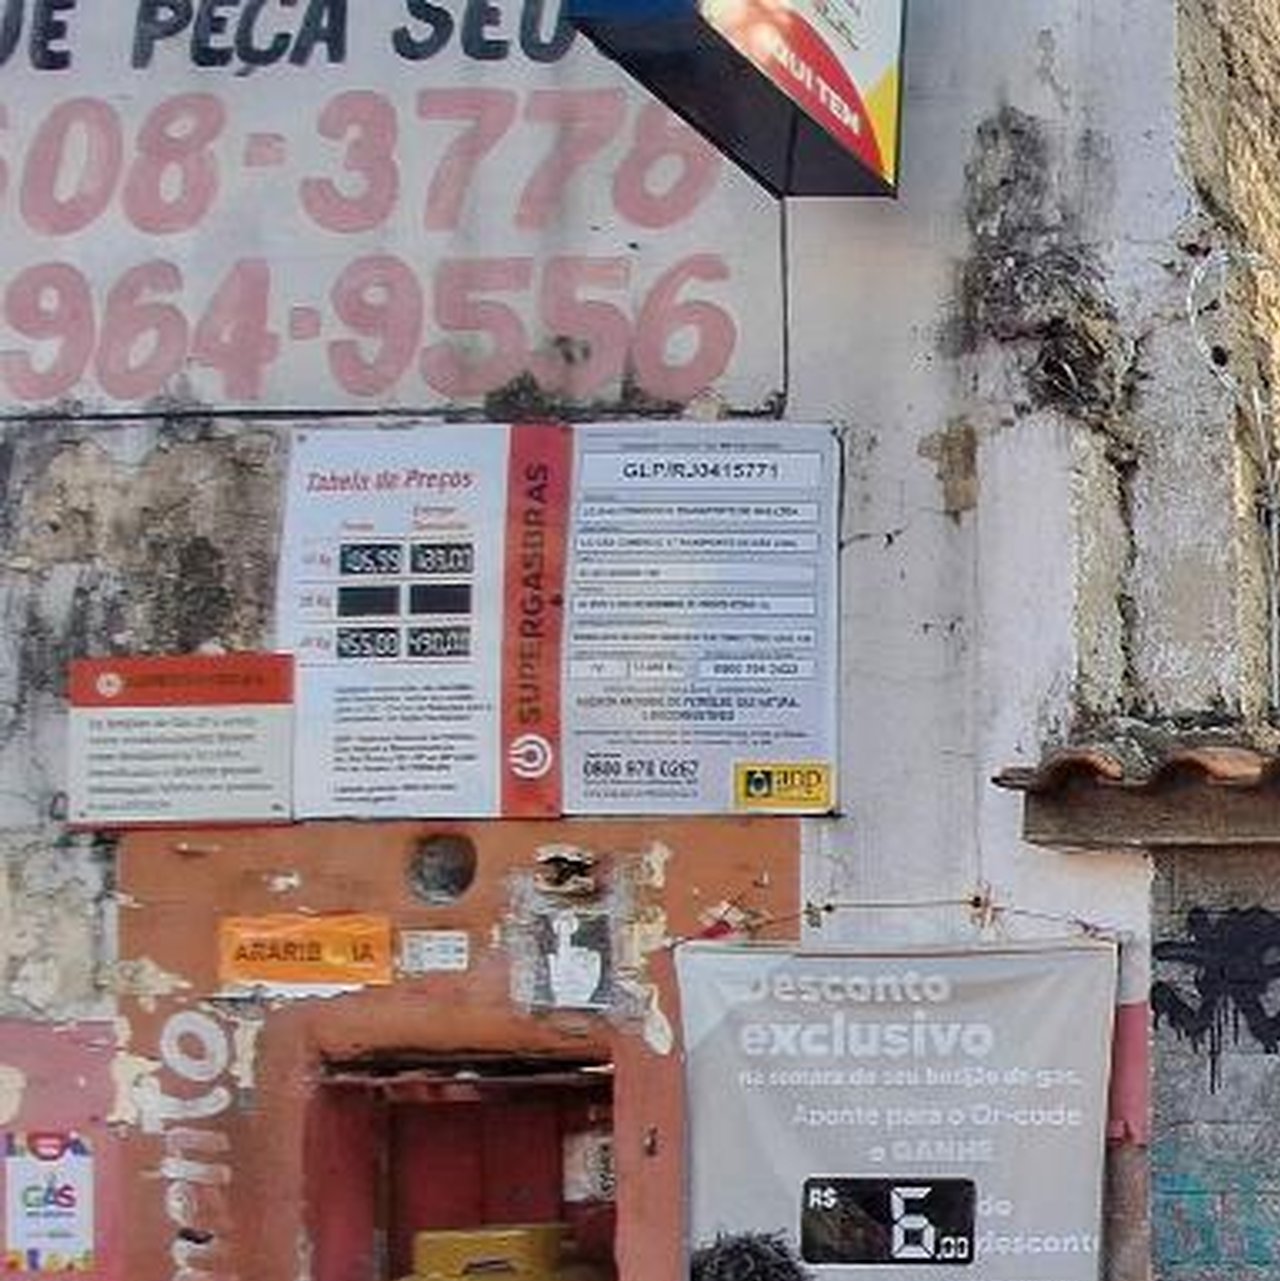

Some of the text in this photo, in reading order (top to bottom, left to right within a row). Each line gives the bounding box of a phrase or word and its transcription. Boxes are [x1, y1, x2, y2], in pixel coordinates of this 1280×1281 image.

[131, 0, 348, 76] PEÇA
[392, 0, 577, 63] SEU
[0, 88, 722, 237] 08-3778
[307, 468, 473, 492] Tabela de Preços
[517, 463, 549, 724] SUPERGASBRAS
[741, 1011, 995, 1057] exclusivo
[808, 1185, 838, 1209] R$
[977, 1230, 1098, 1255] descont
